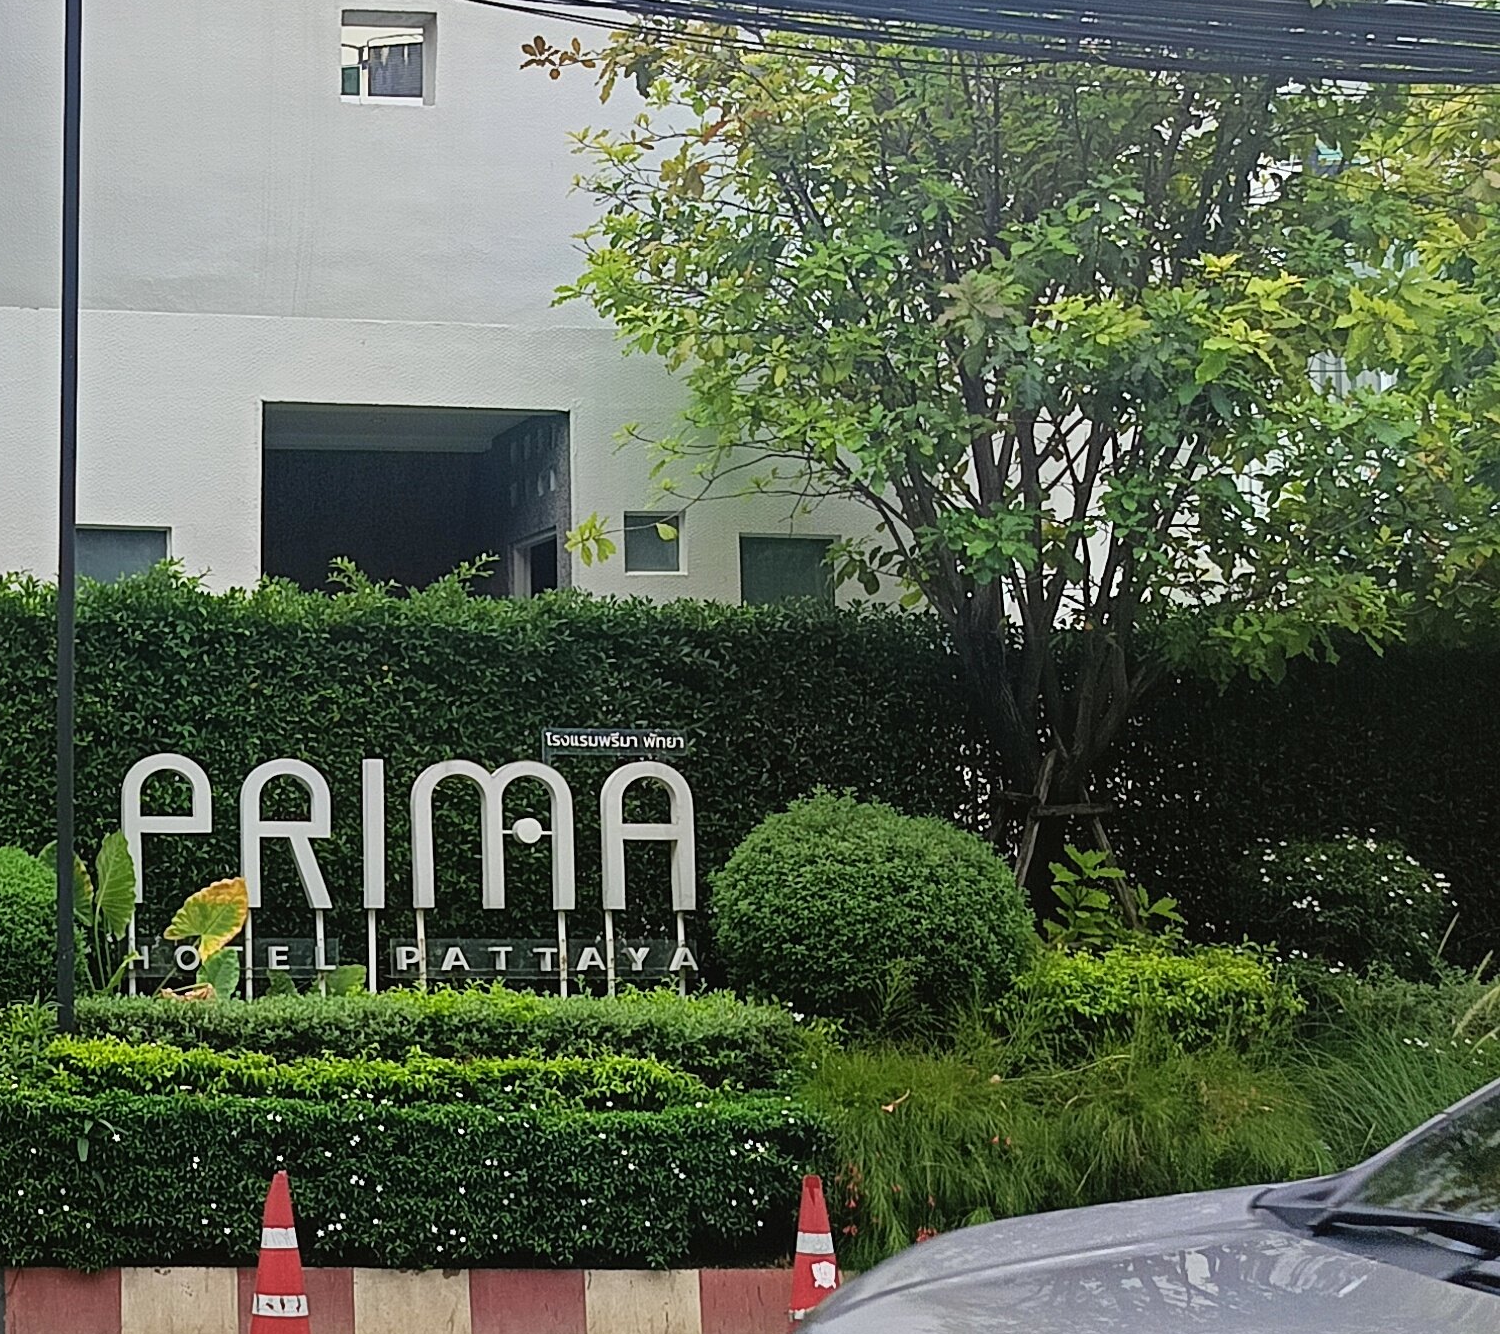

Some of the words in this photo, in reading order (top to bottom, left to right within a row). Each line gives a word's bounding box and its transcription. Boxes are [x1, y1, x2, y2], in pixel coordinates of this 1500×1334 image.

[643, 732, 685, 749] พัทยา
[120, 753, 697, 911] PRIMA
[395, 946, 699, 971] PATTAYA
